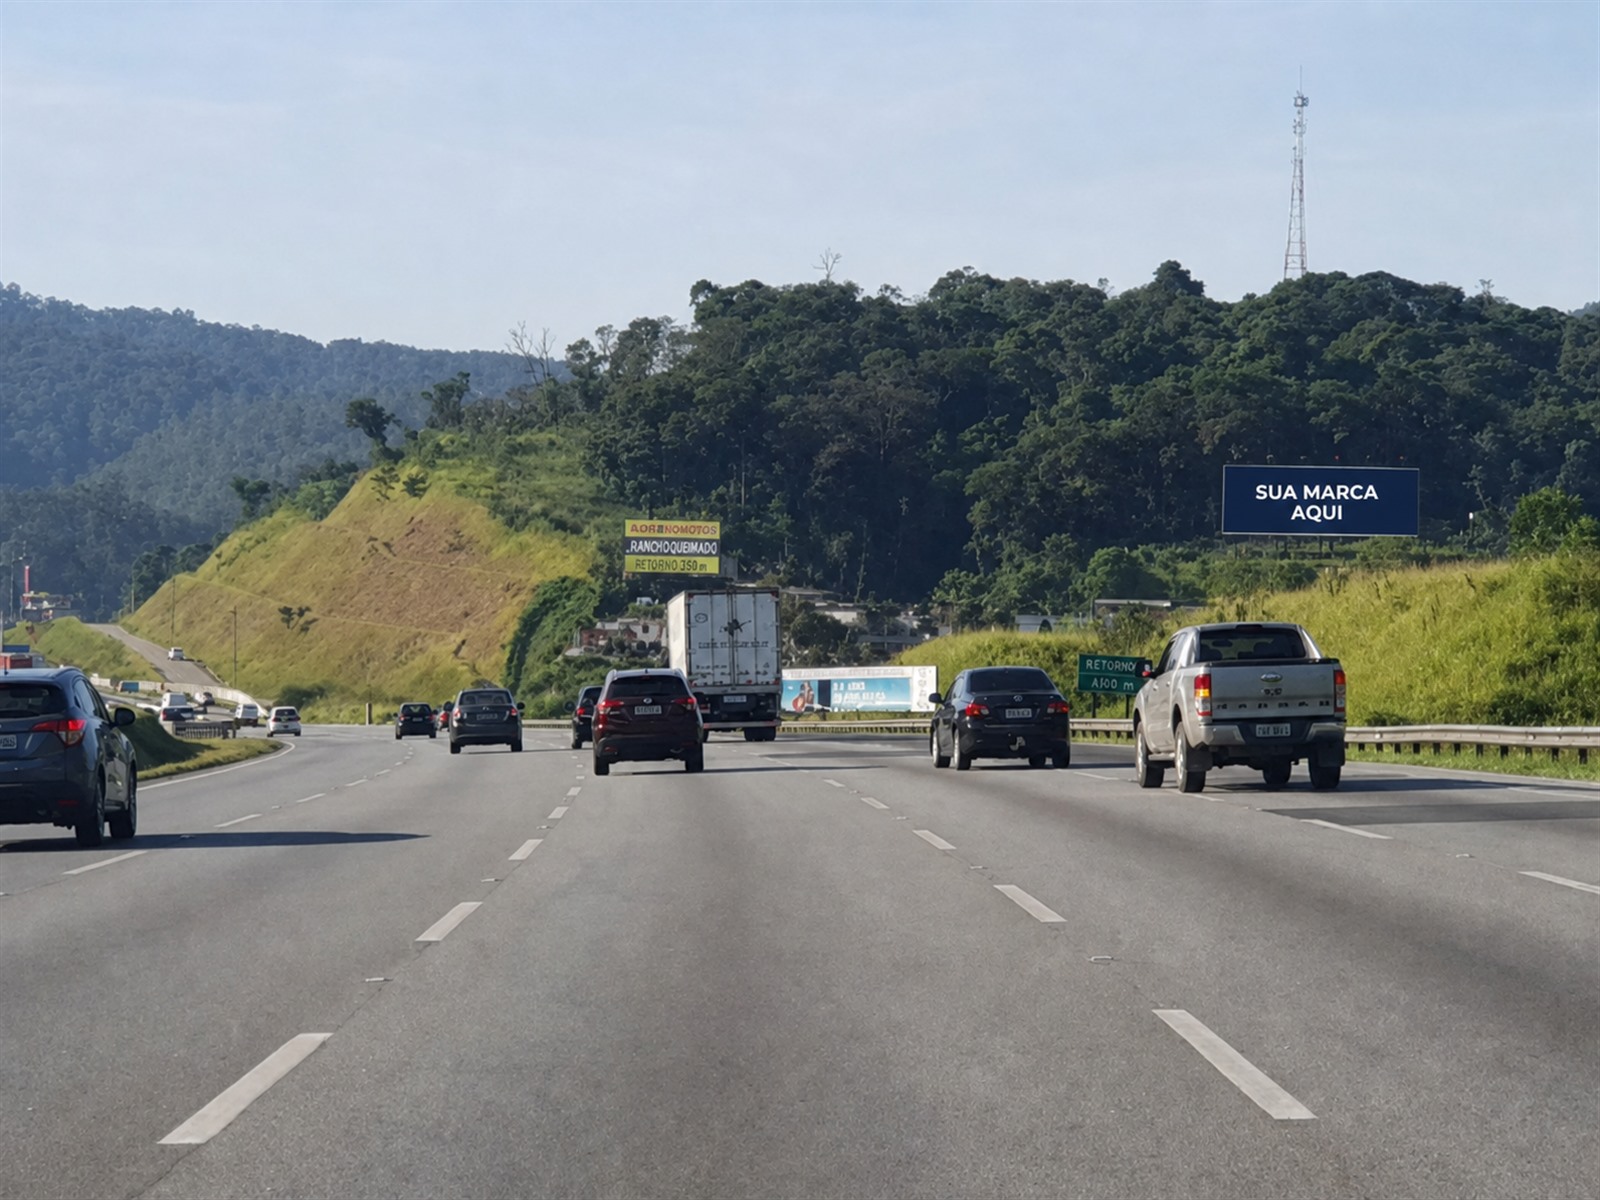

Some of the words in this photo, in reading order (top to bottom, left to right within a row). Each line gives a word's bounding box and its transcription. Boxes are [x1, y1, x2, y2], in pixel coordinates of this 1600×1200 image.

[1255, 484, 1298, 500] SUA
[1302, 484, 1379, 500] MARCA
[1290, 504, 1343, 523] AQUI
[635, 559, 678, 571] RETORNO
[1086, 659, 1136, 672] RETORNO
[1123, 682, 1134, 691] m
